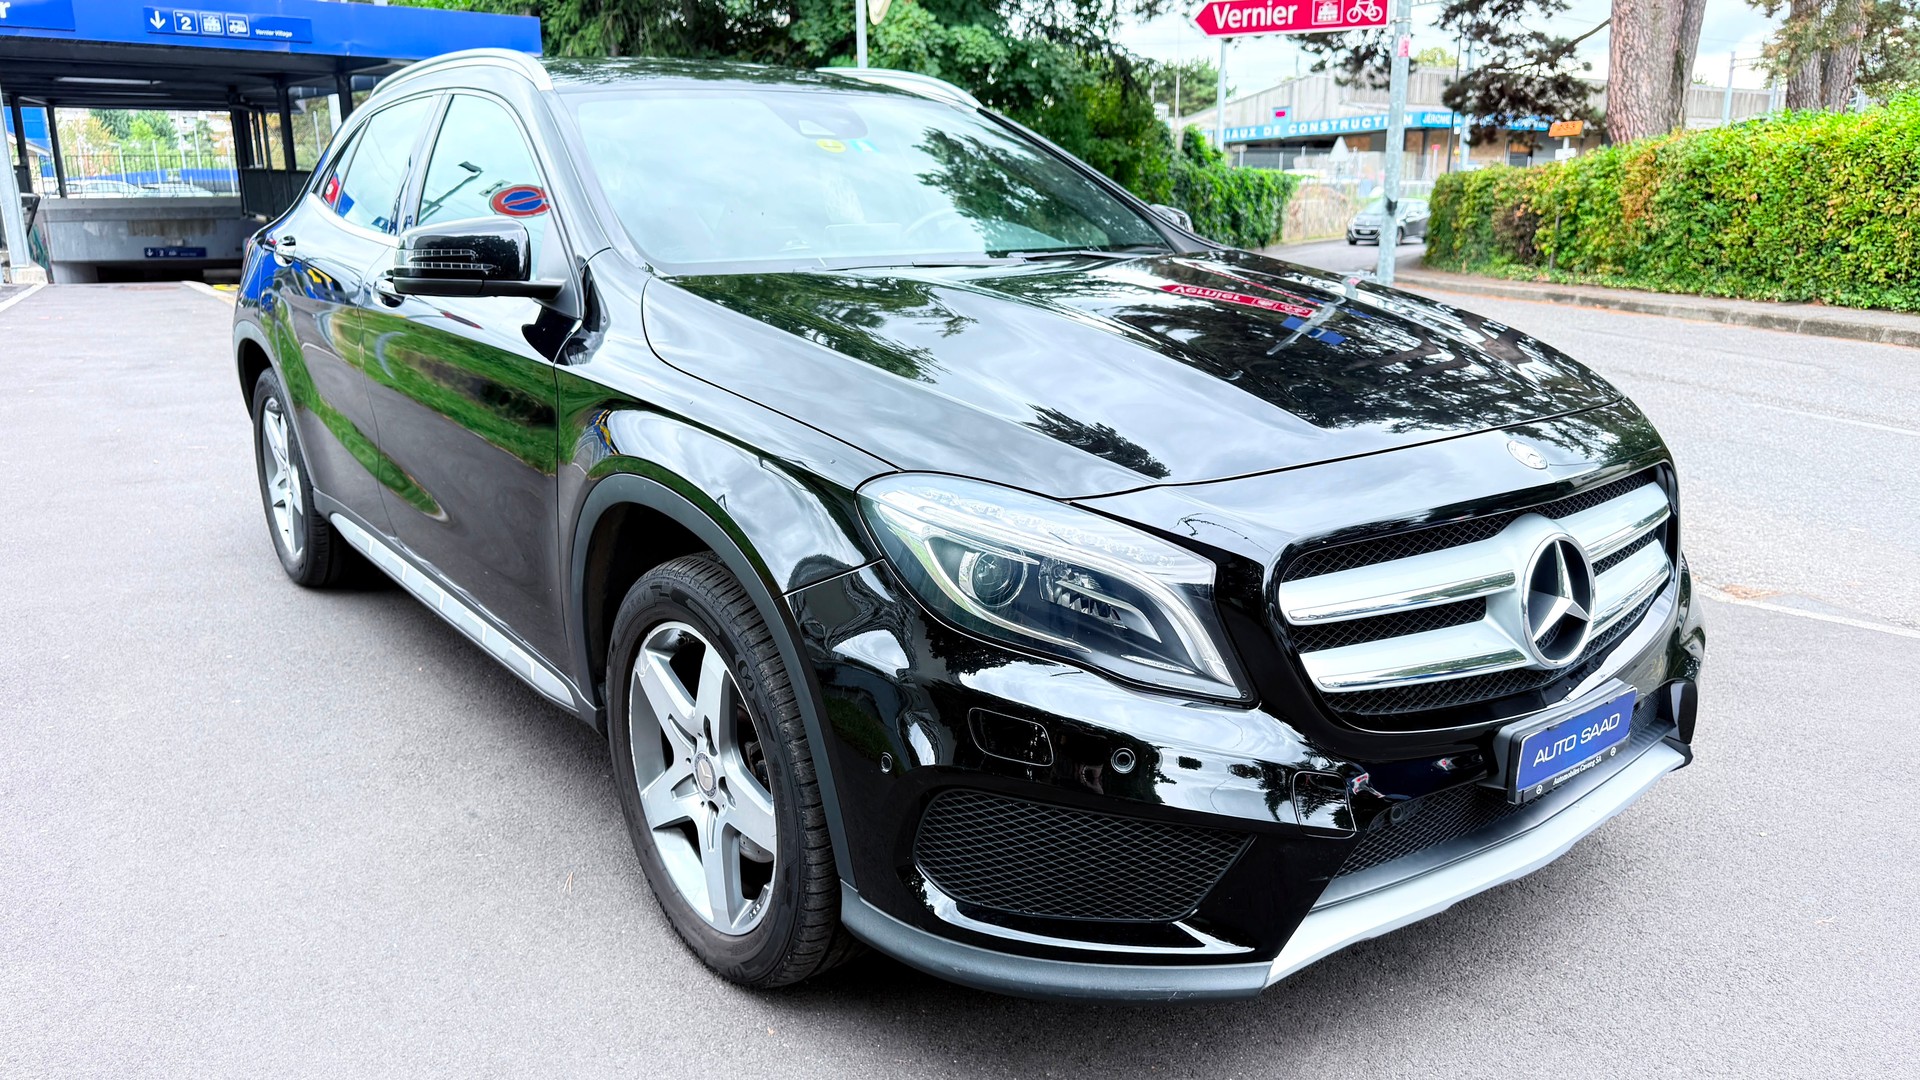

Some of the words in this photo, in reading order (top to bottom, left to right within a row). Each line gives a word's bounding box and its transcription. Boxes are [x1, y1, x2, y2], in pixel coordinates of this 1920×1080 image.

[180, 16, 192, 31] 2
[1213, 0, 1298, 29] Vernier
[255, 28, 274, 36] Vernier
[275, 29, 293, 38] Village
[1226, 127, 1257, 140] IAUX
[1263, 125, 1281, 136] DE
[1288, 114, 1414, 134] CONSTRUCTIN
[1533, 734, 1577, 767] AUTO
[1580, 713, 1621, 744] SAAD
[1552, 767, 1580, 785] Automobiles
